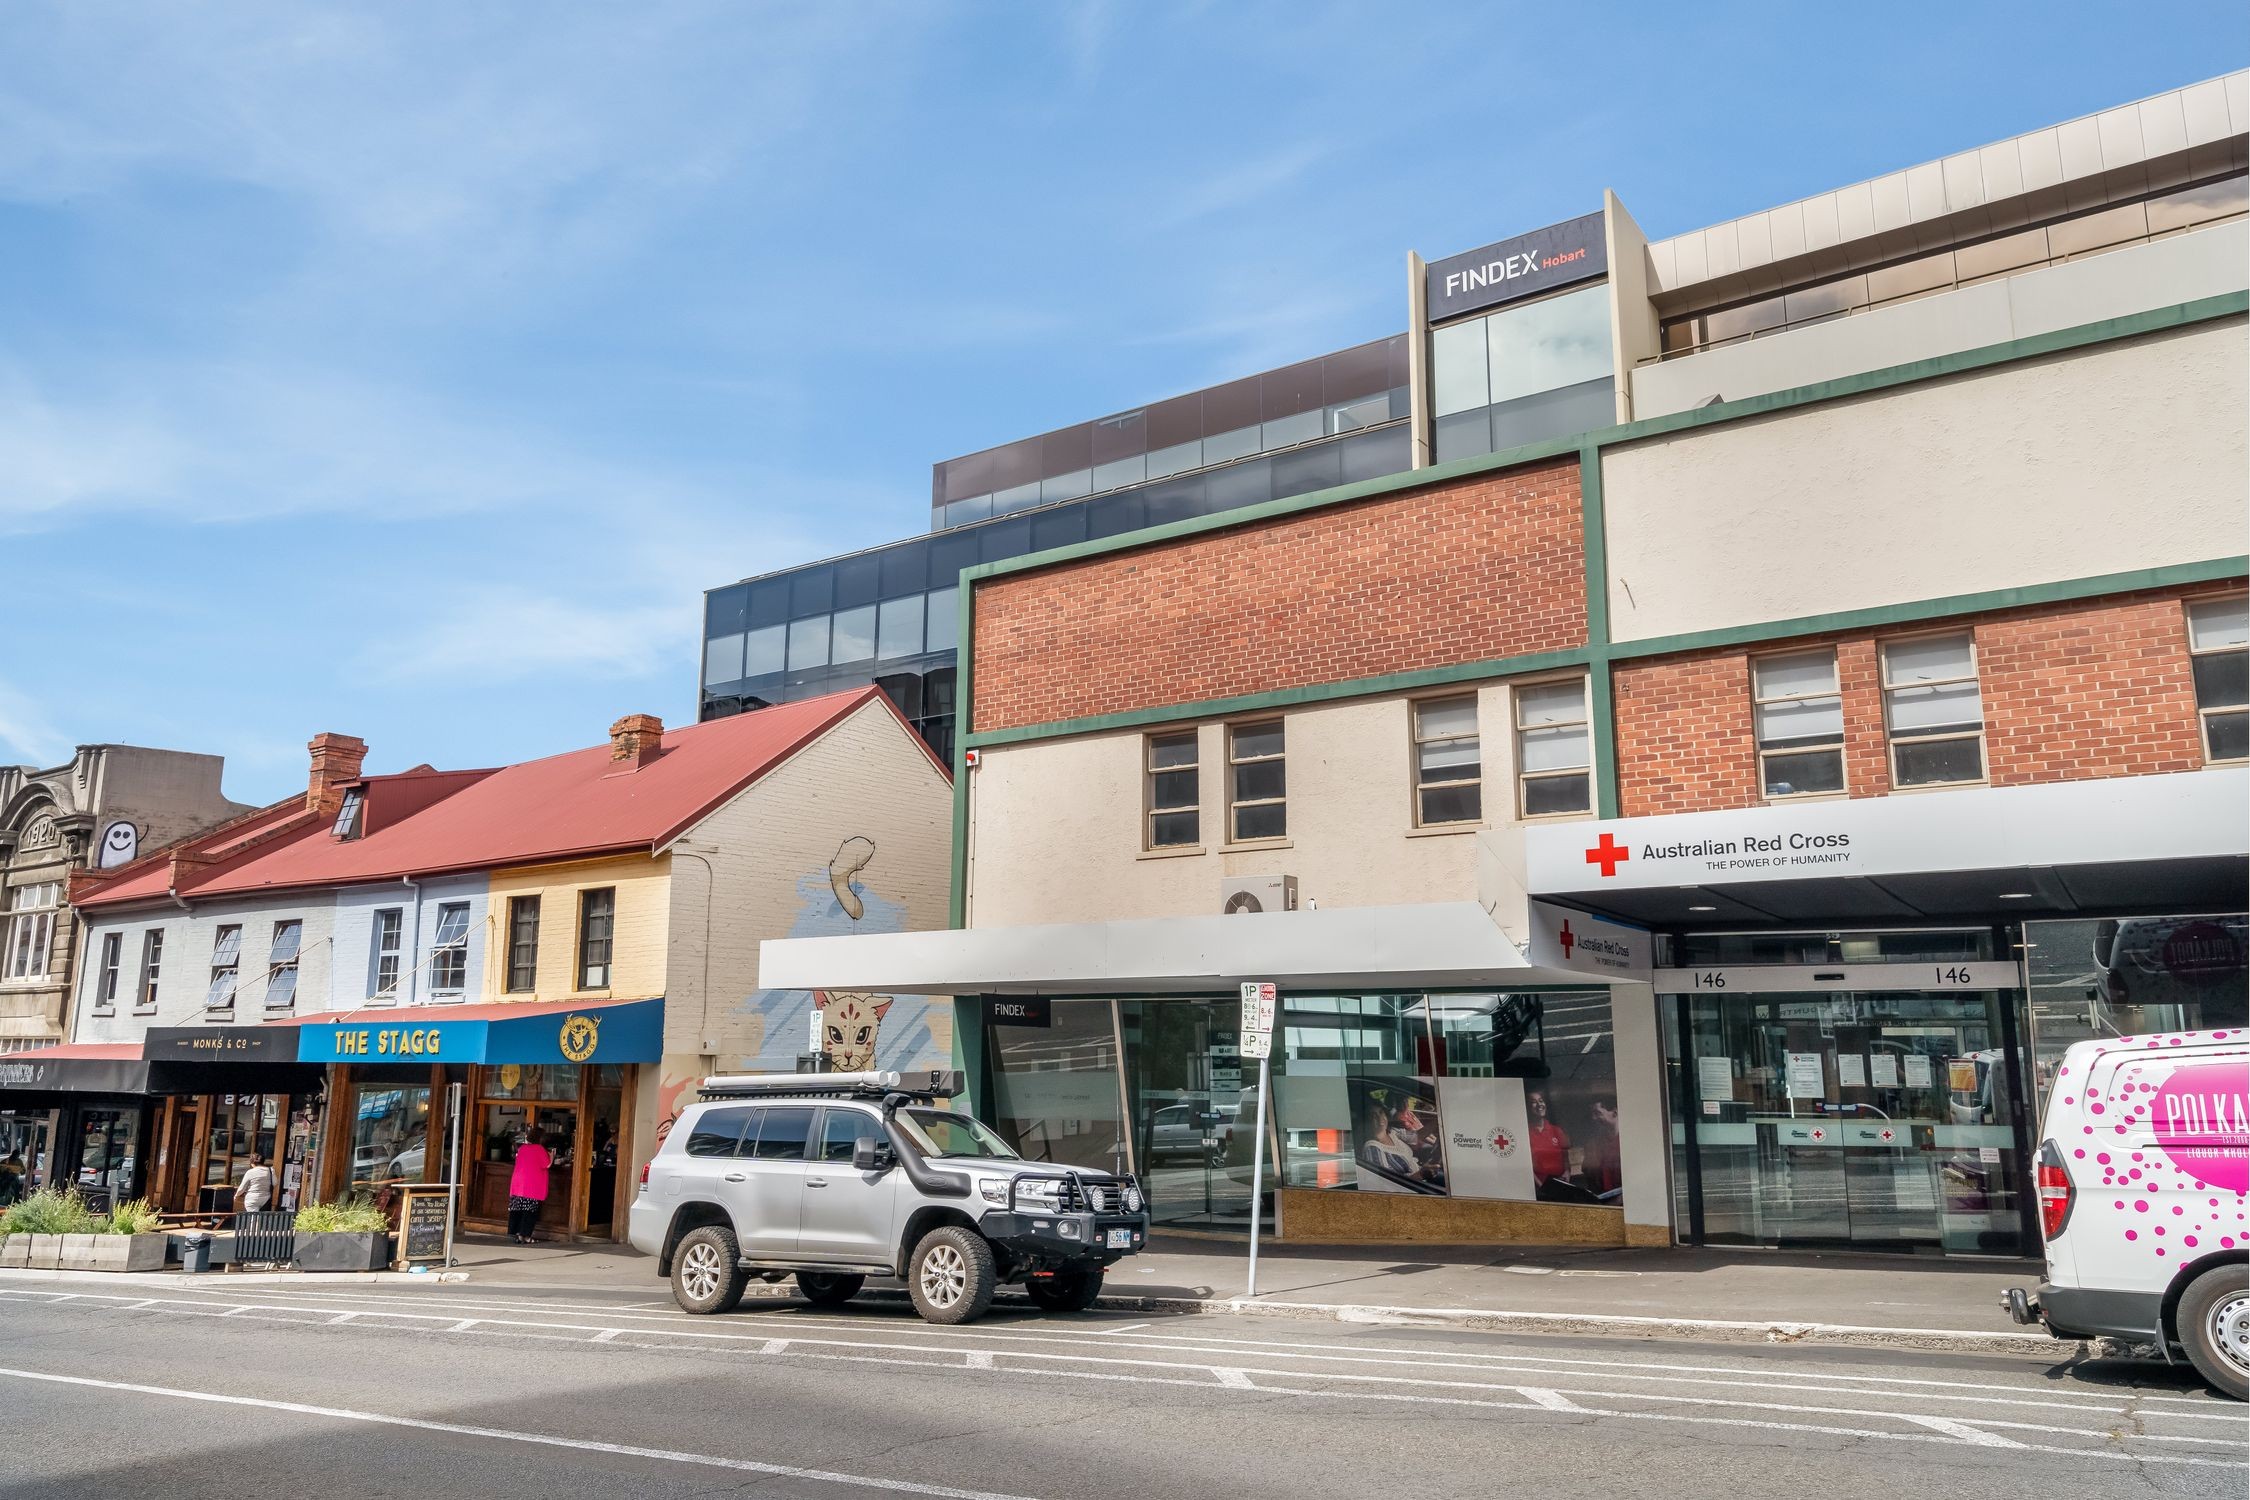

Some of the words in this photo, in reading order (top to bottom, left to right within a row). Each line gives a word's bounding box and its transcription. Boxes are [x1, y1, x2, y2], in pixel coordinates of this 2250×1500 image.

[1446, 250, 1539, 297] FINDEX
[1543, 248, 1586, 269] Hobart
[1642, 840, 1737, 860] Australian
[1743, 835, 1782, 853] Red
[1789, 833, 1850, 850] Cross
[1706, 861, 1728, 870] THE
[1730, 858, 1770, 869] POWER
[1773, 857, 1788, 866] OF
[1791, 853, 1850, 865] HUMANITY
[1577, 935, 1604, 952] Australian
[1604, 940, 1615, 954] Red
[1615, 942, 1630, 957] Cross
[1694, 972, 1726, 988] 146
[1936, 967, 1971, 984] 146
[1245, 985, 1257, 997] 1P
[995, 1003, 1025, 1016] FINDEX
[193, 1039, 222, 1049] MONKS
[226, 1040, 232, 1048] &
[336, 1031, 368, 1054] THE
[378, 1029, 440, 1054] STAGG
[563, 1043, 572, 1057] THE
[574, 1043, 595, 1060] STAGG
[2165, 1093, 2249, 1137] POLKA
[1453, 1137, 1476, 1145] power
[1488, 1128, 1516, 1143] AUSTRALIAN
[1489, 1143, 1498, 1153] RED
[1499, 1144, 1516, 1157] CROSS
[2187, 1147, 2219, 1159] LIQUOR
[2223, 1147, 2249, 1159] WHOL
